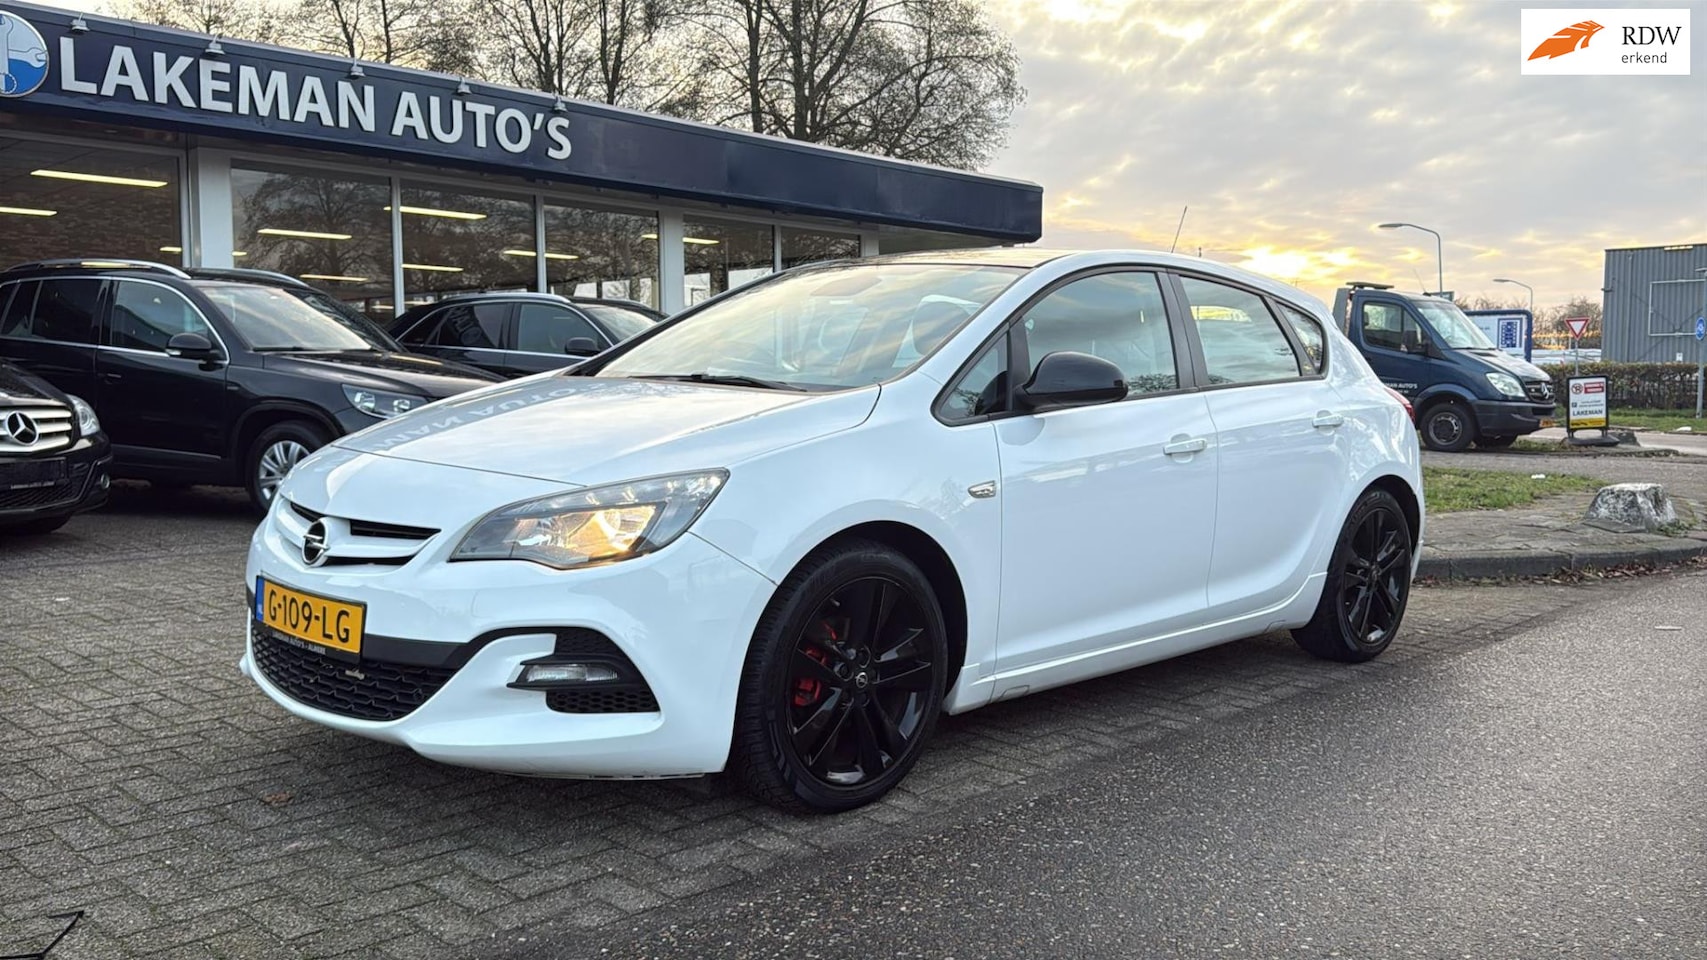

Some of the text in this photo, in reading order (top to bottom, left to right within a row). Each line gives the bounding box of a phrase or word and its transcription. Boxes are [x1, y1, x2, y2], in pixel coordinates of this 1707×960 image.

[59, 36, 573, 162] LAKEMAN AUTO'S
[268, 589, 351, 644] G-109-LG
